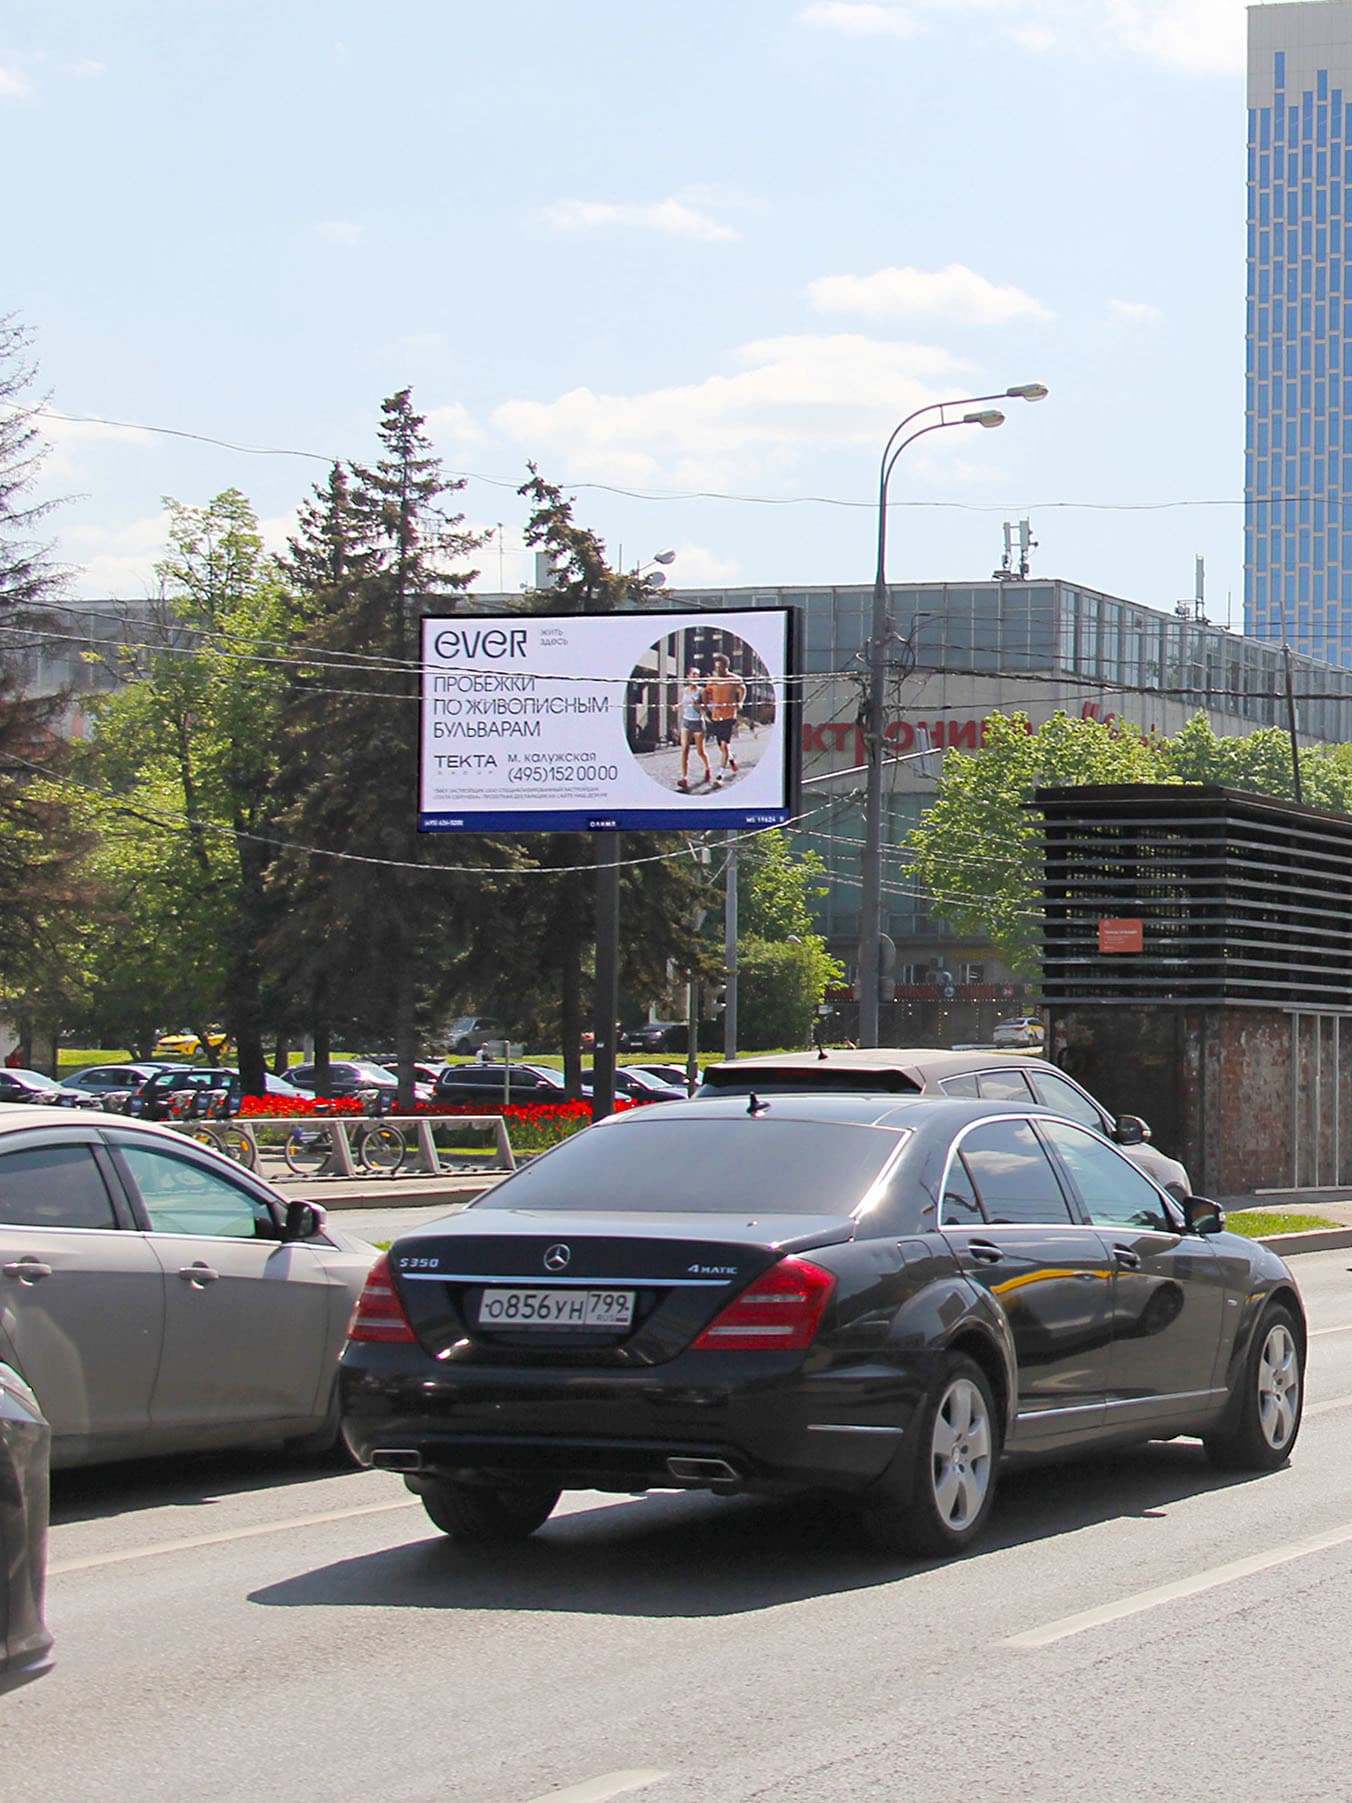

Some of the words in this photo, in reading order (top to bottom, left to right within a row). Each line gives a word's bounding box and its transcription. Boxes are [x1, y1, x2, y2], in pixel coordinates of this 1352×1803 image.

[433, 675, 536, 693] ПРОБЕЖКИ
[433, 699, 463, 716] ПО
[466, 697, 609, 716] ЖИВОПИСНЫМ
[433, 720, 541, 739] БУЛЬВАРАМ
[433, 754, 498, 769] ТЕКТА
[524, 752, 597, 764] калужская
[687, 1263, 738, 1274] 4MATIC
[589, 1293, 626, 1313] 799
